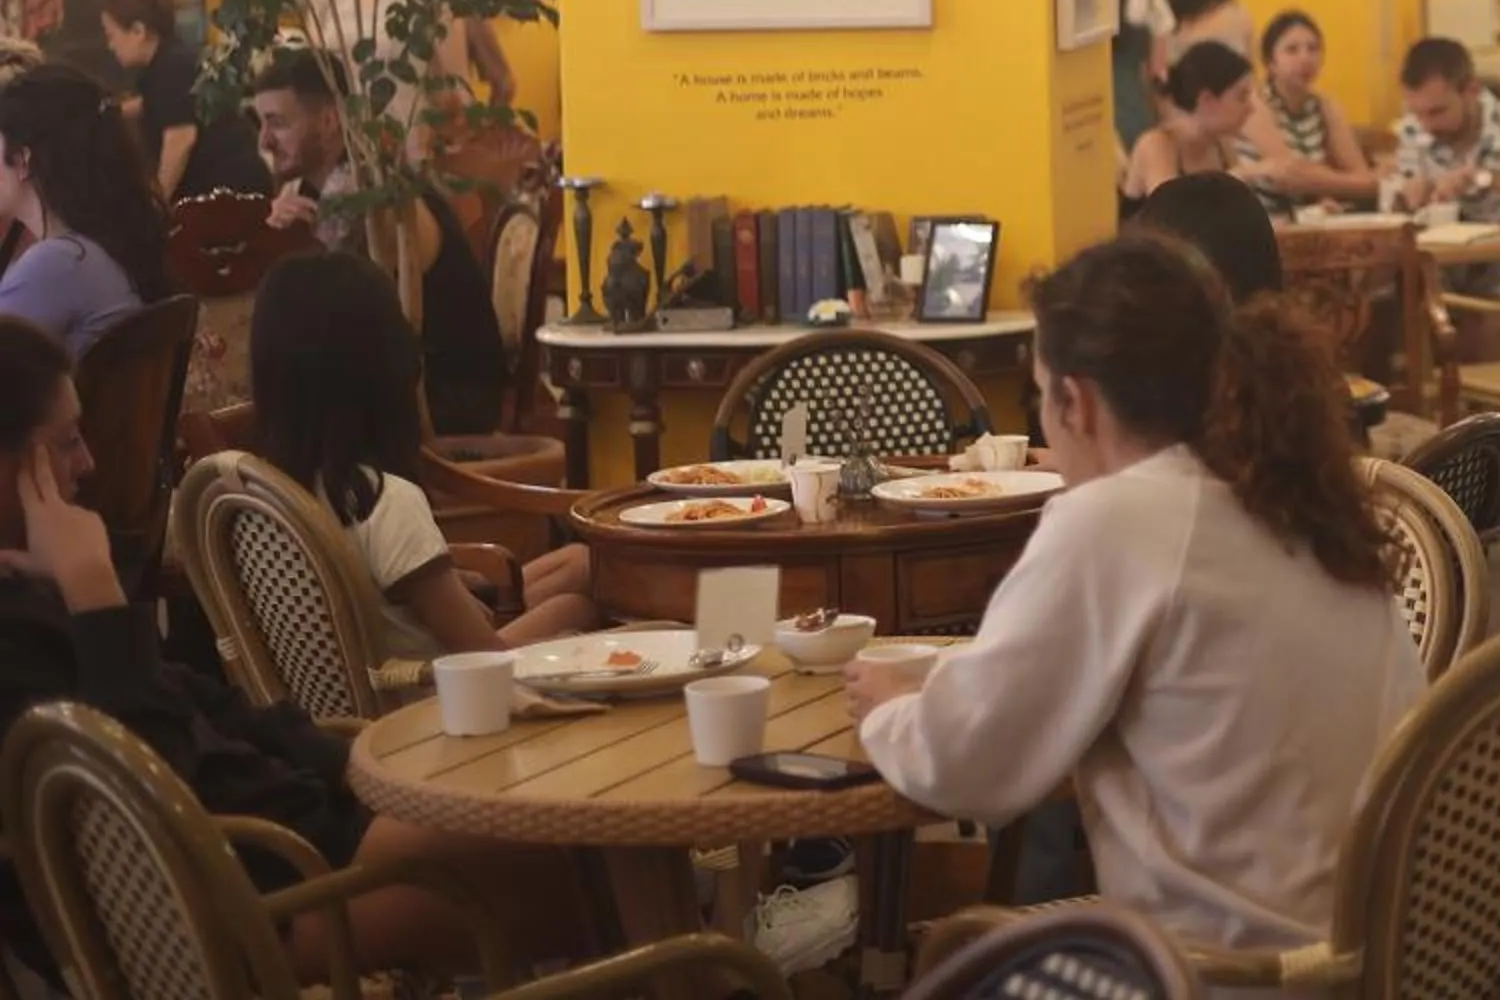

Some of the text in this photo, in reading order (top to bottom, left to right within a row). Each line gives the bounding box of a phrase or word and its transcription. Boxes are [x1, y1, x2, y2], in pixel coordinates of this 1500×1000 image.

[694, 72, 732, 86] house
[737, 73, 747, 84] is
[751, 71, 786, 84] made
[792, 71, 805, 83] of
[808, 69, 845, 83] bricks
[849, 68, 874, 81] and
[716, 86, 882, 104] A home is made of hopes
[756, 107, 781, 120] and
